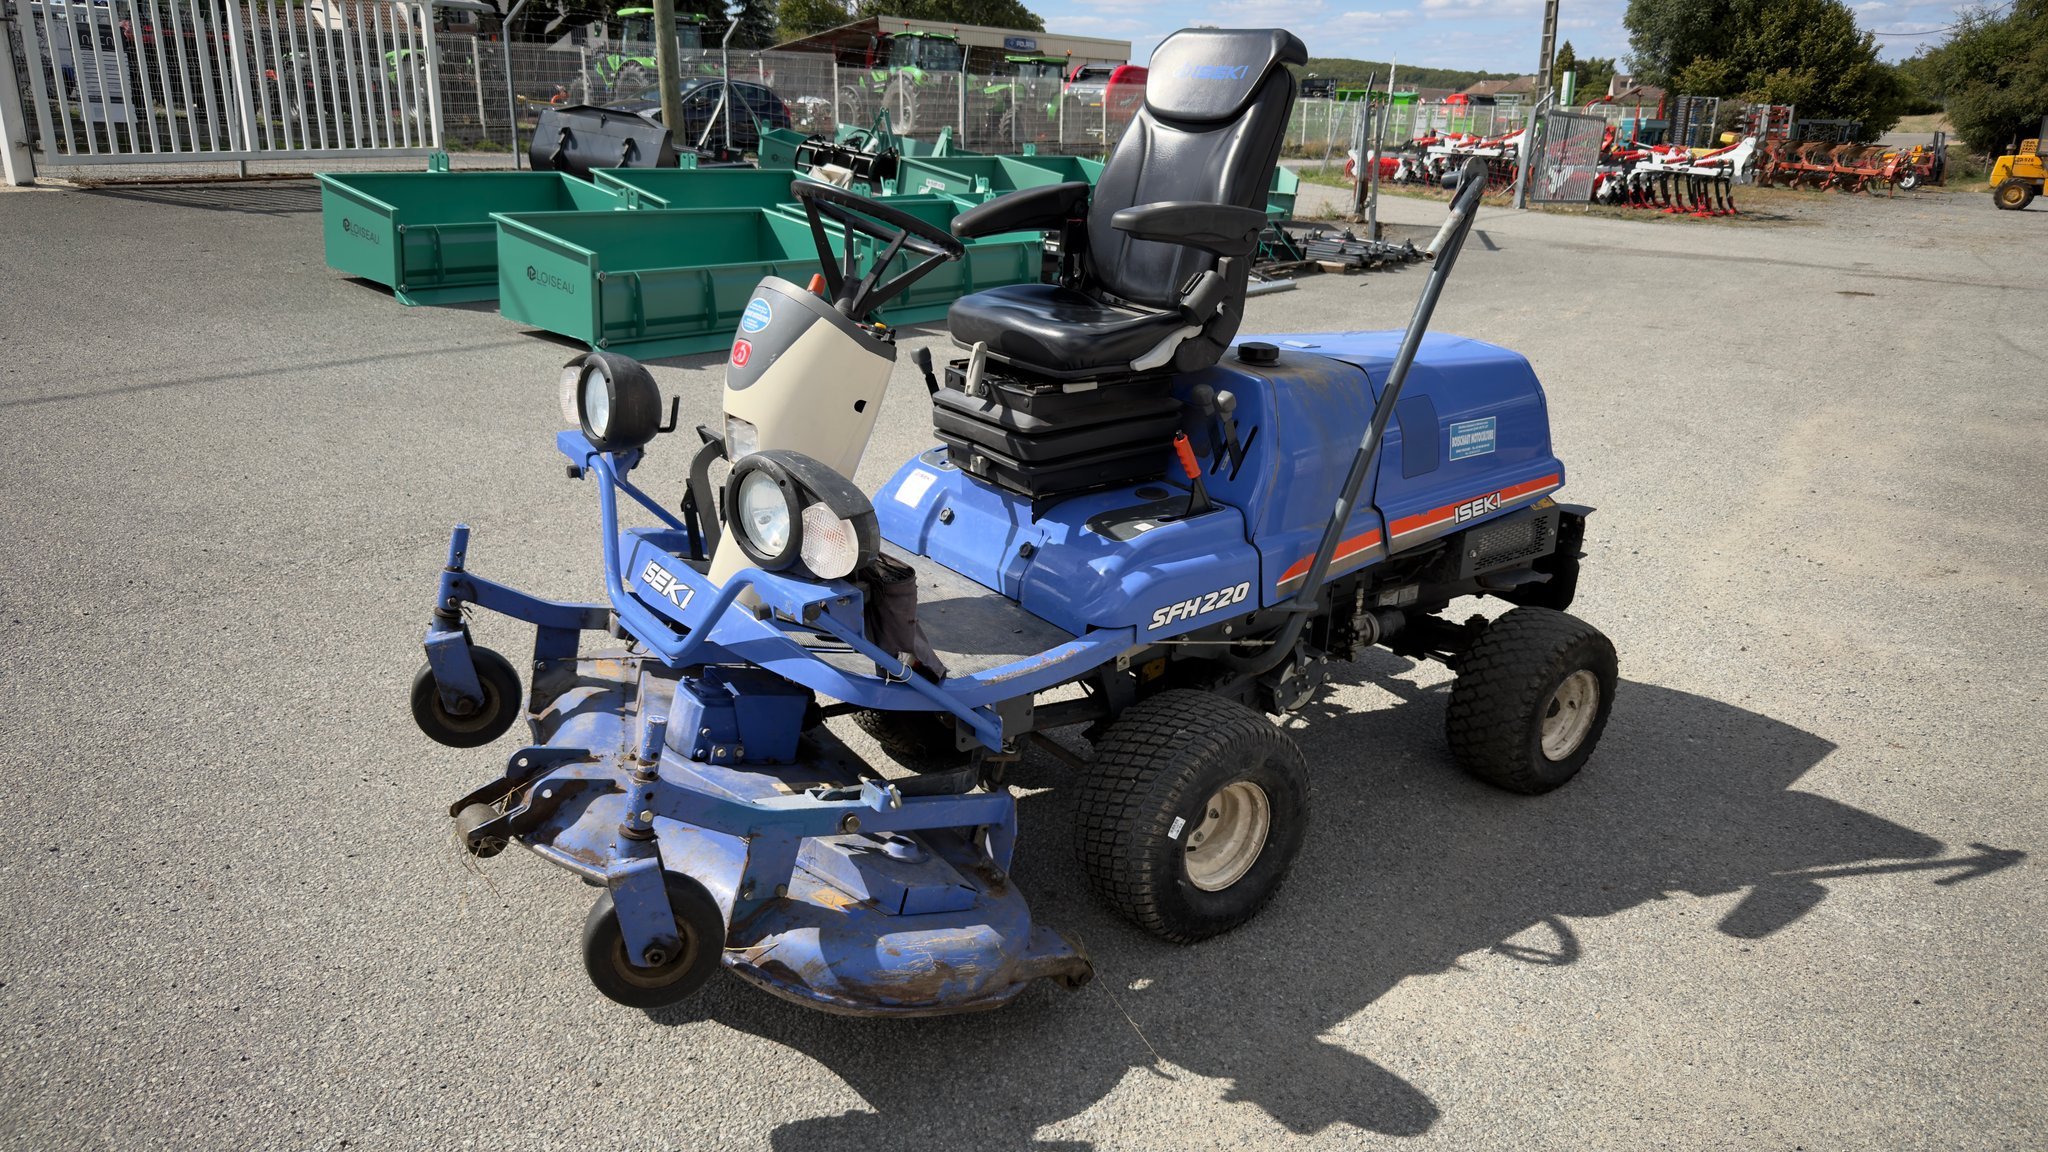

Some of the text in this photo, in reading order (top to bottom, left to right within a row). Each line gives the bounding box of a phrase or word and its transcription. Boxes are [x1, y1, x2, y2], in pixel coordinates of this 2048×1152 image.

[351, 222, 380, 245] LOISEAU
[536, 269, 575, 295] LOISEAU
[1454, 491, 1501, 524] ISEKI
[641, 559, 696, 611] ISEKI
